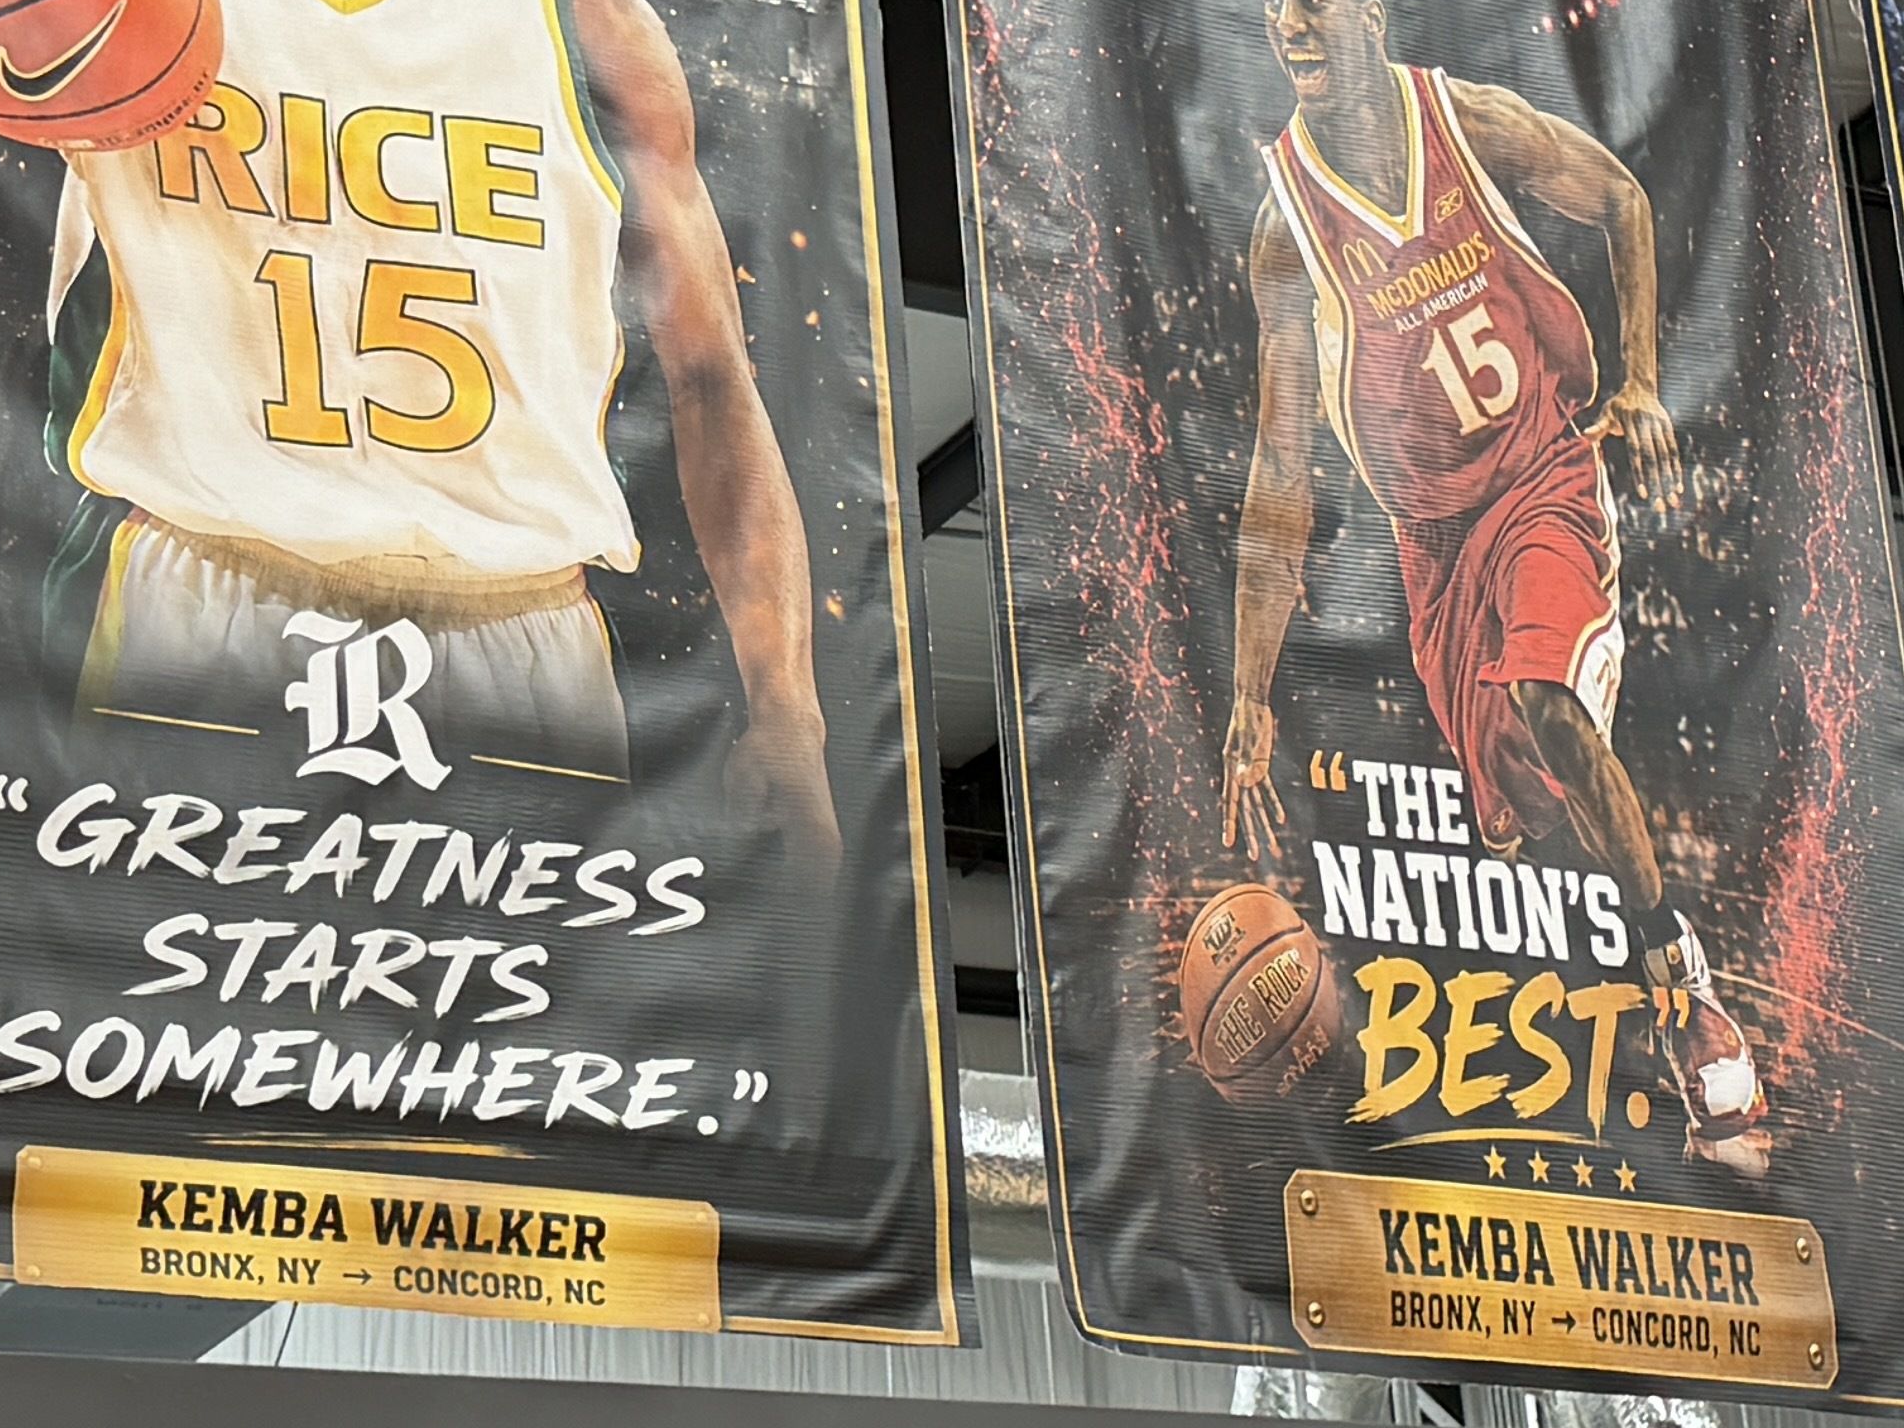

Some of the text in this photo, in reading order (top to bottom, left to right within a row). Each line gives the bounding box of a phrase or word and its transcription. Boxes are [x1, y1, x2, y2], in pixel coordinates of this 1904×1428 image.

[154, 74, 546, 251] RICE
[255, 250, 497, 455] 15
[1395, 272, 1489, 335] ALL AMERICAN
[1420, 303, 1520, 438] 15
[1312, 840, 1631, 968] NATION'S
[121, 911, 551, 1024] STARTS
[1216, 993, 1266, 1064] THE
[1249, 948, 1312, 1023] ROCK
[136, 1179, 609, 1264] KEMBA WALKER
[140, 1246, 607, 1308] BRONX, NY CONCORD, NC
[1379, 1207, 1761, 1308] KEMBA WALKER
[1390, 1290, 1762, 1360] BRONX, NY CONCORD, NC
